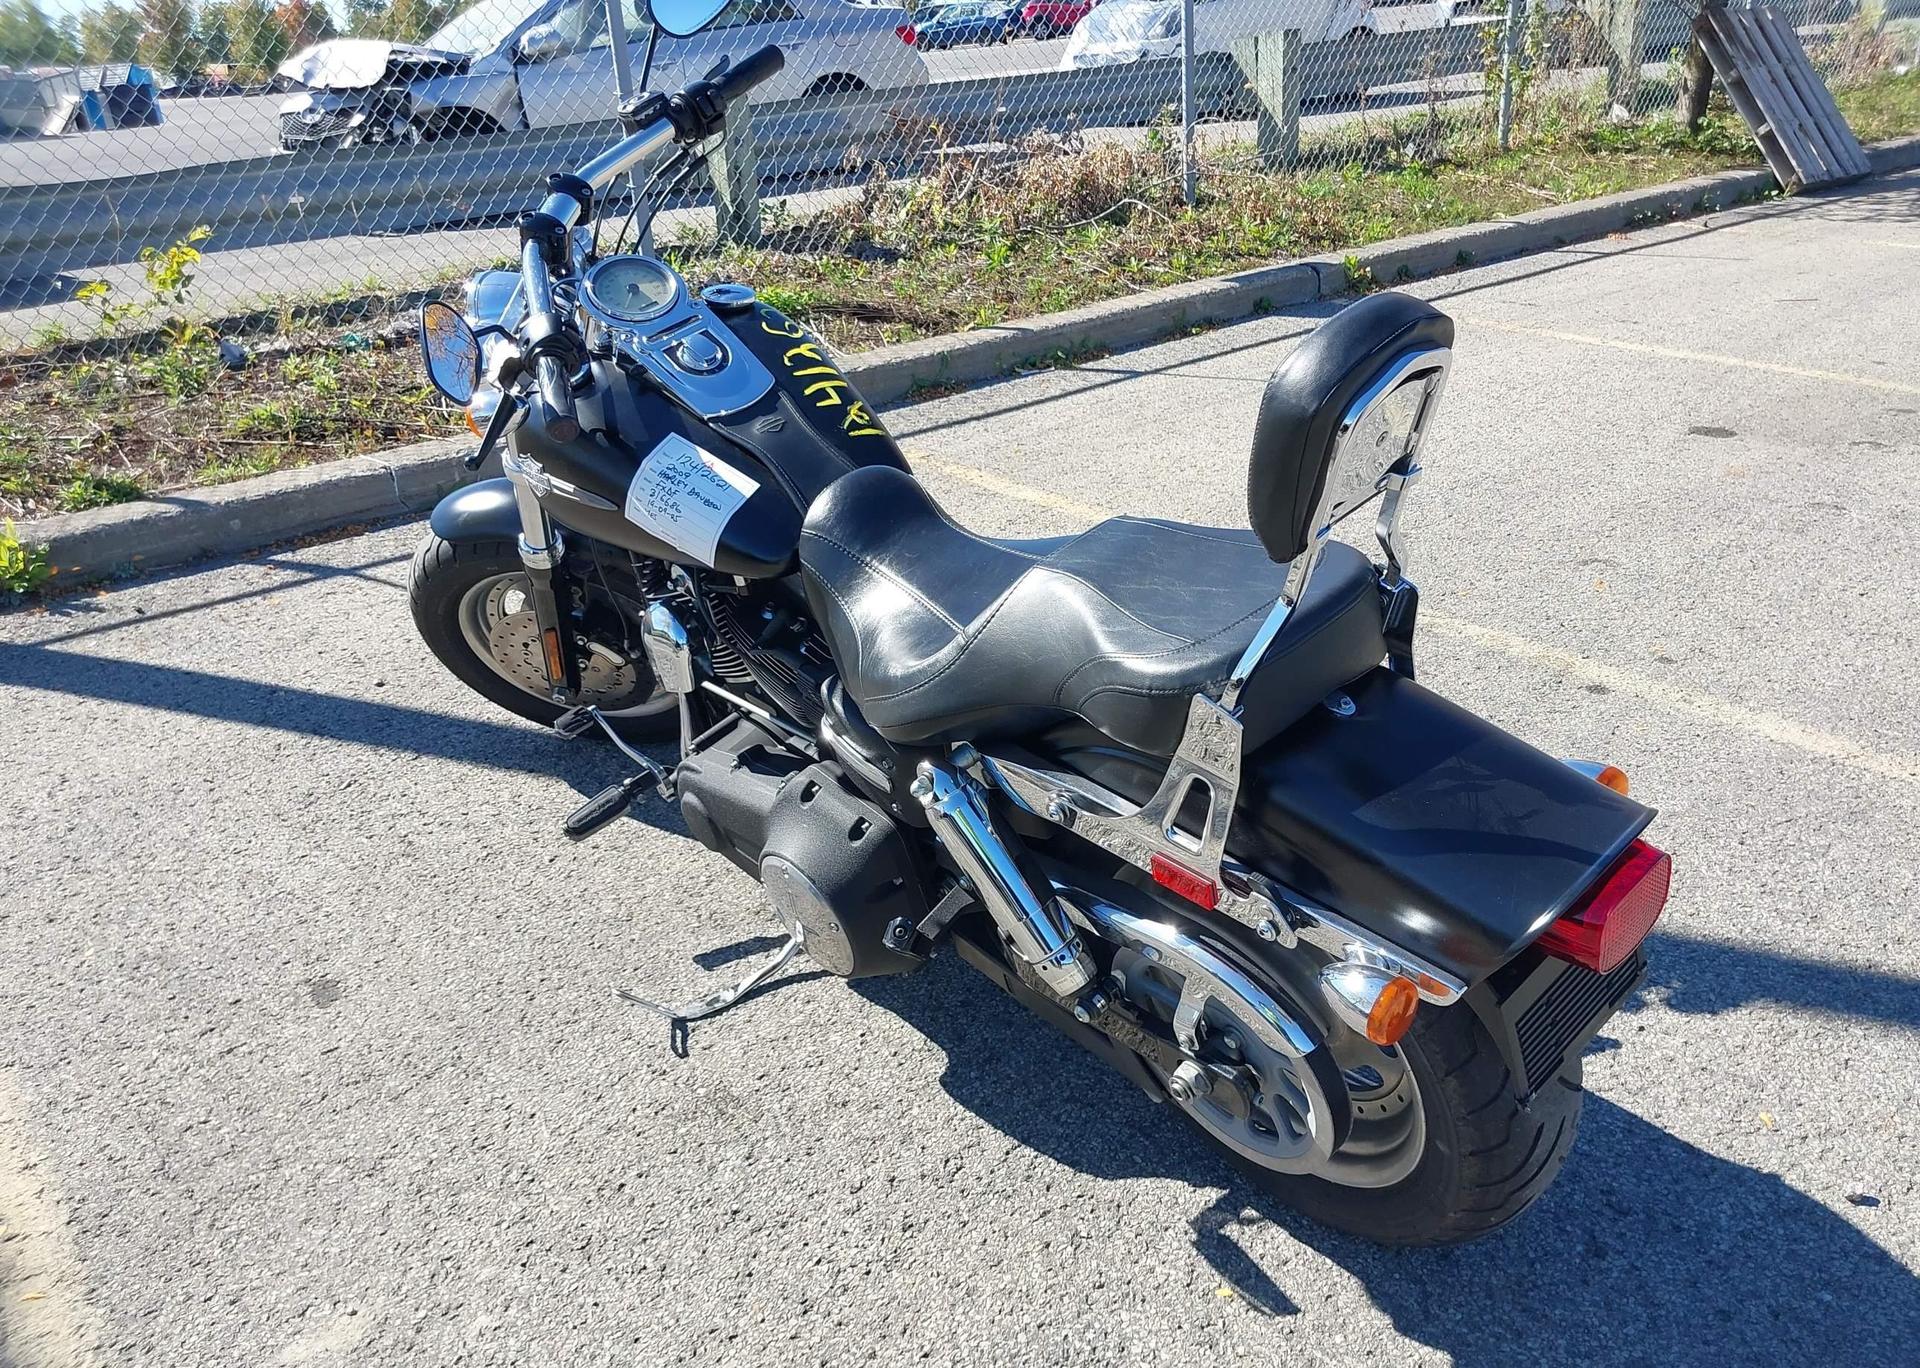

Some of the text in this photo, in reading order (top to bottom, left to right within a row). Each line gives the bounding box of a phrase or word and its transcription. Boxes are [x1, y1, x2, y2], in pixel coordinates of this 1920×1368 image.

[657, 469, 688, 489] HARLEY
[666, 463, 692, 479] 2009
[649, 488, 682, 514] 316686
